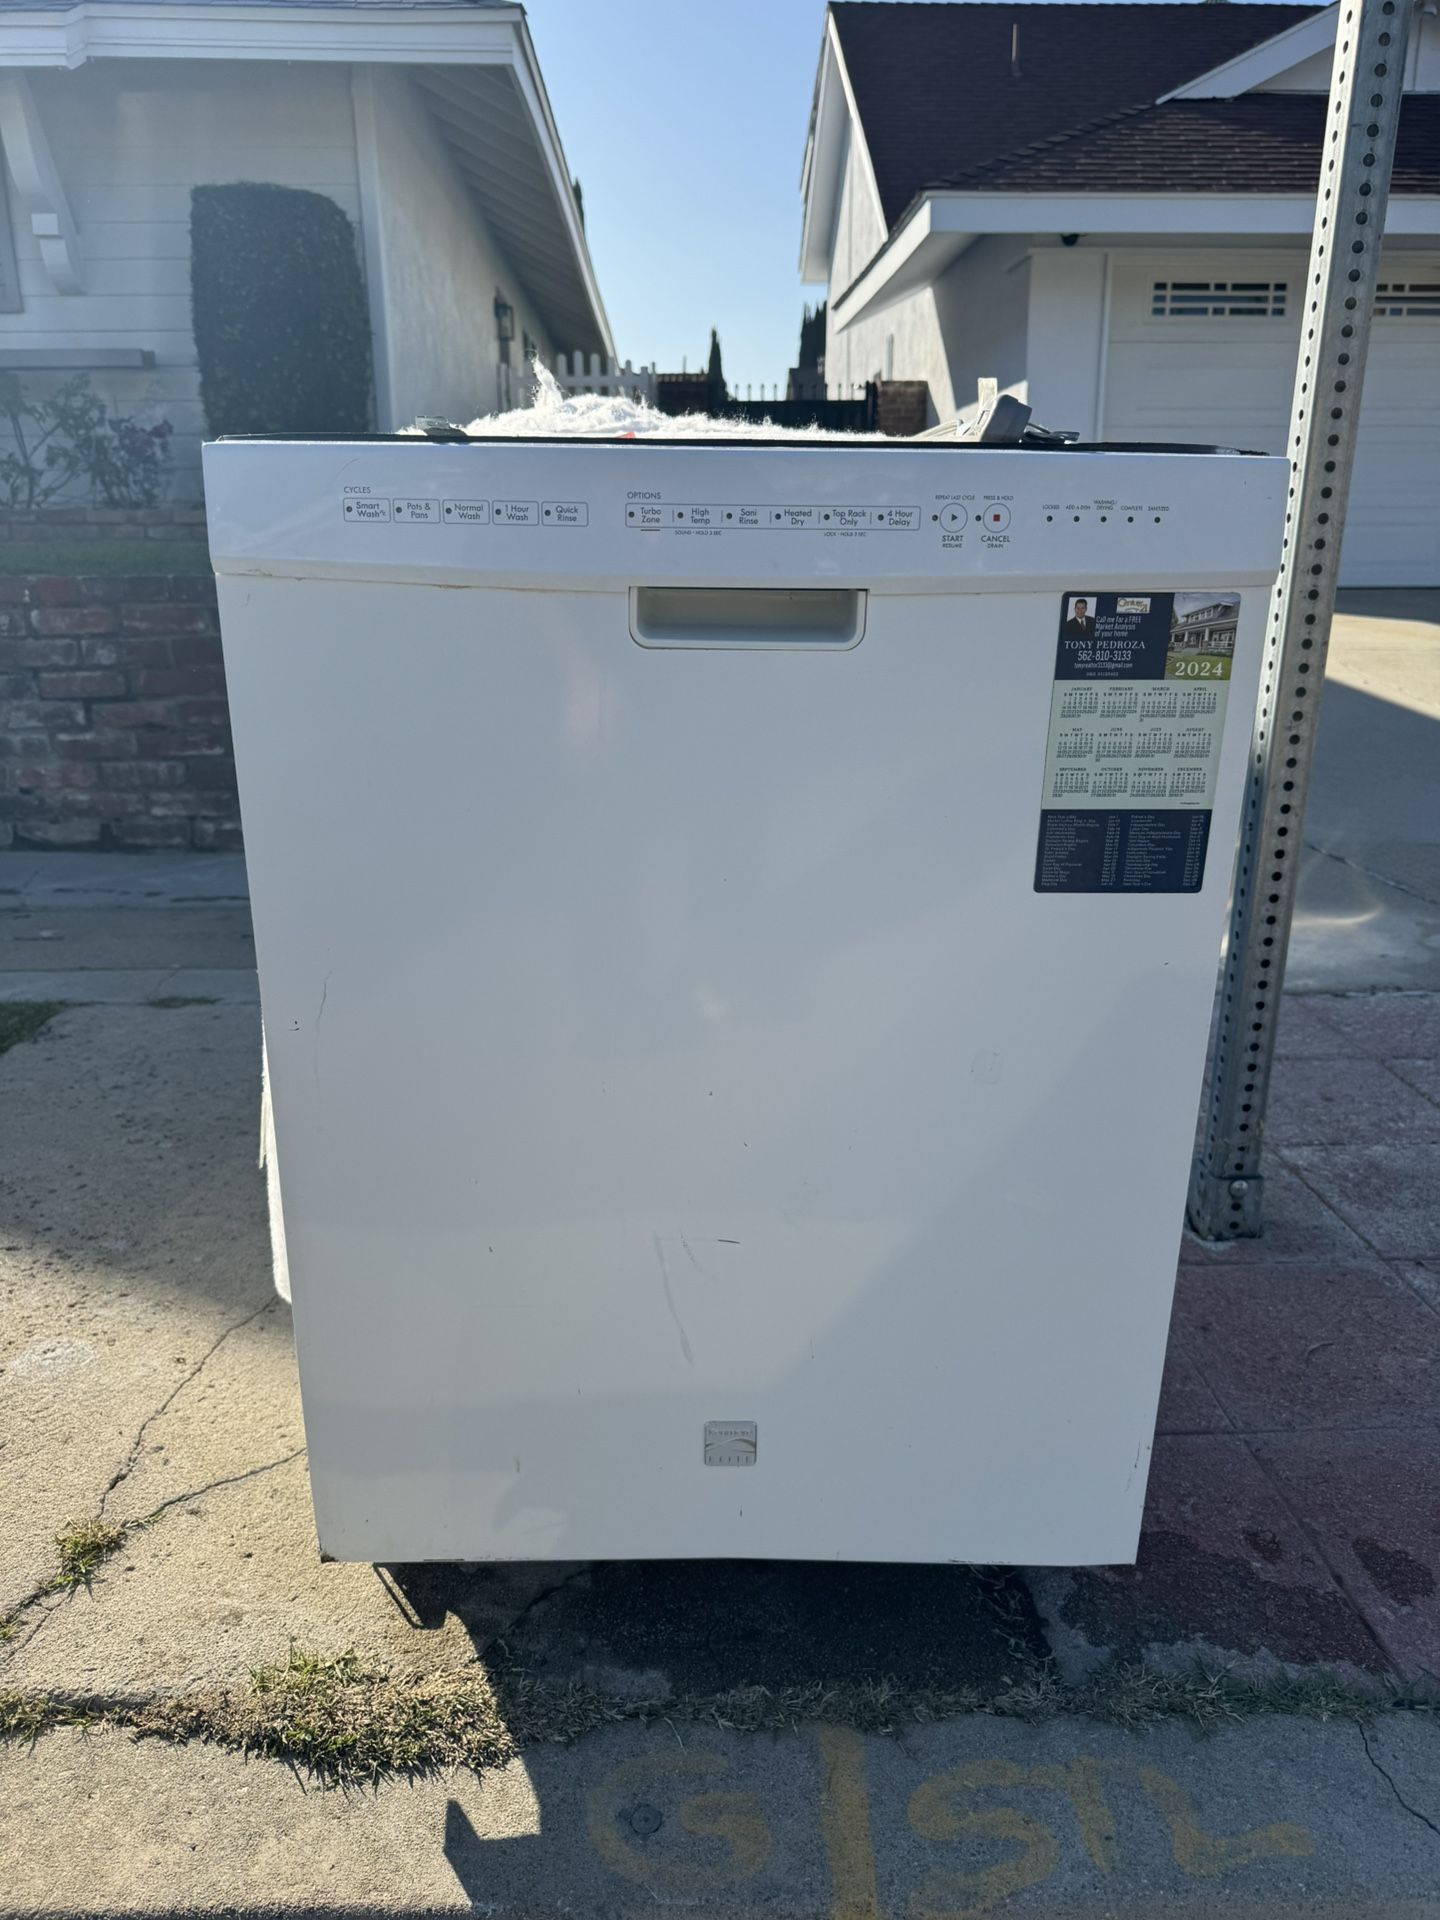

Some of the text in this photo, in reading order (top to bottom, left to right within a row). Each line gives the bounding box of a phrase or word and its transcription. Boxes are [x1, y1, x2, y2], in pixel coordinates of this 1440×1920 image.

[344, 486, 371, 494] CYCLES
[626, 491, 662, 499] OPTIONS
[356, 501, 380, 510] Smart
[407, 502, 422, 510] Pots
[454, 503, 484, 512] Normal
[510, 505, 529, 513] Hour
[555, 505, 579, 514] Quick
[411, 511, 428, 519] Pans
[640, 507, 662, 515] Turbo
[691, 508, 710, 517] High
[740, 508, 757, 517] Sani
[784, 508, 812, 517] Heated
[832, 509, 867, 518] Top Rack
[895, 510, 913, 518] Hour
[506, 513, 529, 521] Wash
[557, 514, 577, 522] Rinse
[641, 515, 661, 523] Zone
[690, 516, 711, 525] Temp
[739, 517, 759, 525] Rinse
[791, 518, 805, 526] Dry
[839, 518, 858, 527] Only
[888, 518, 911, 527] Delay
[1095, 615, 1106, 623] Call
[1115, 615, 1124, 623] for
[1128, 615, 1142, 623] FREE
[1114, 623, 1136, 631] Analysis
[1064, 640, 1146, 649] TONY PEDROZA
[1077, 650, 1132, 661] 562-810-3133
[1175, 661, 1223, 677] 2024
